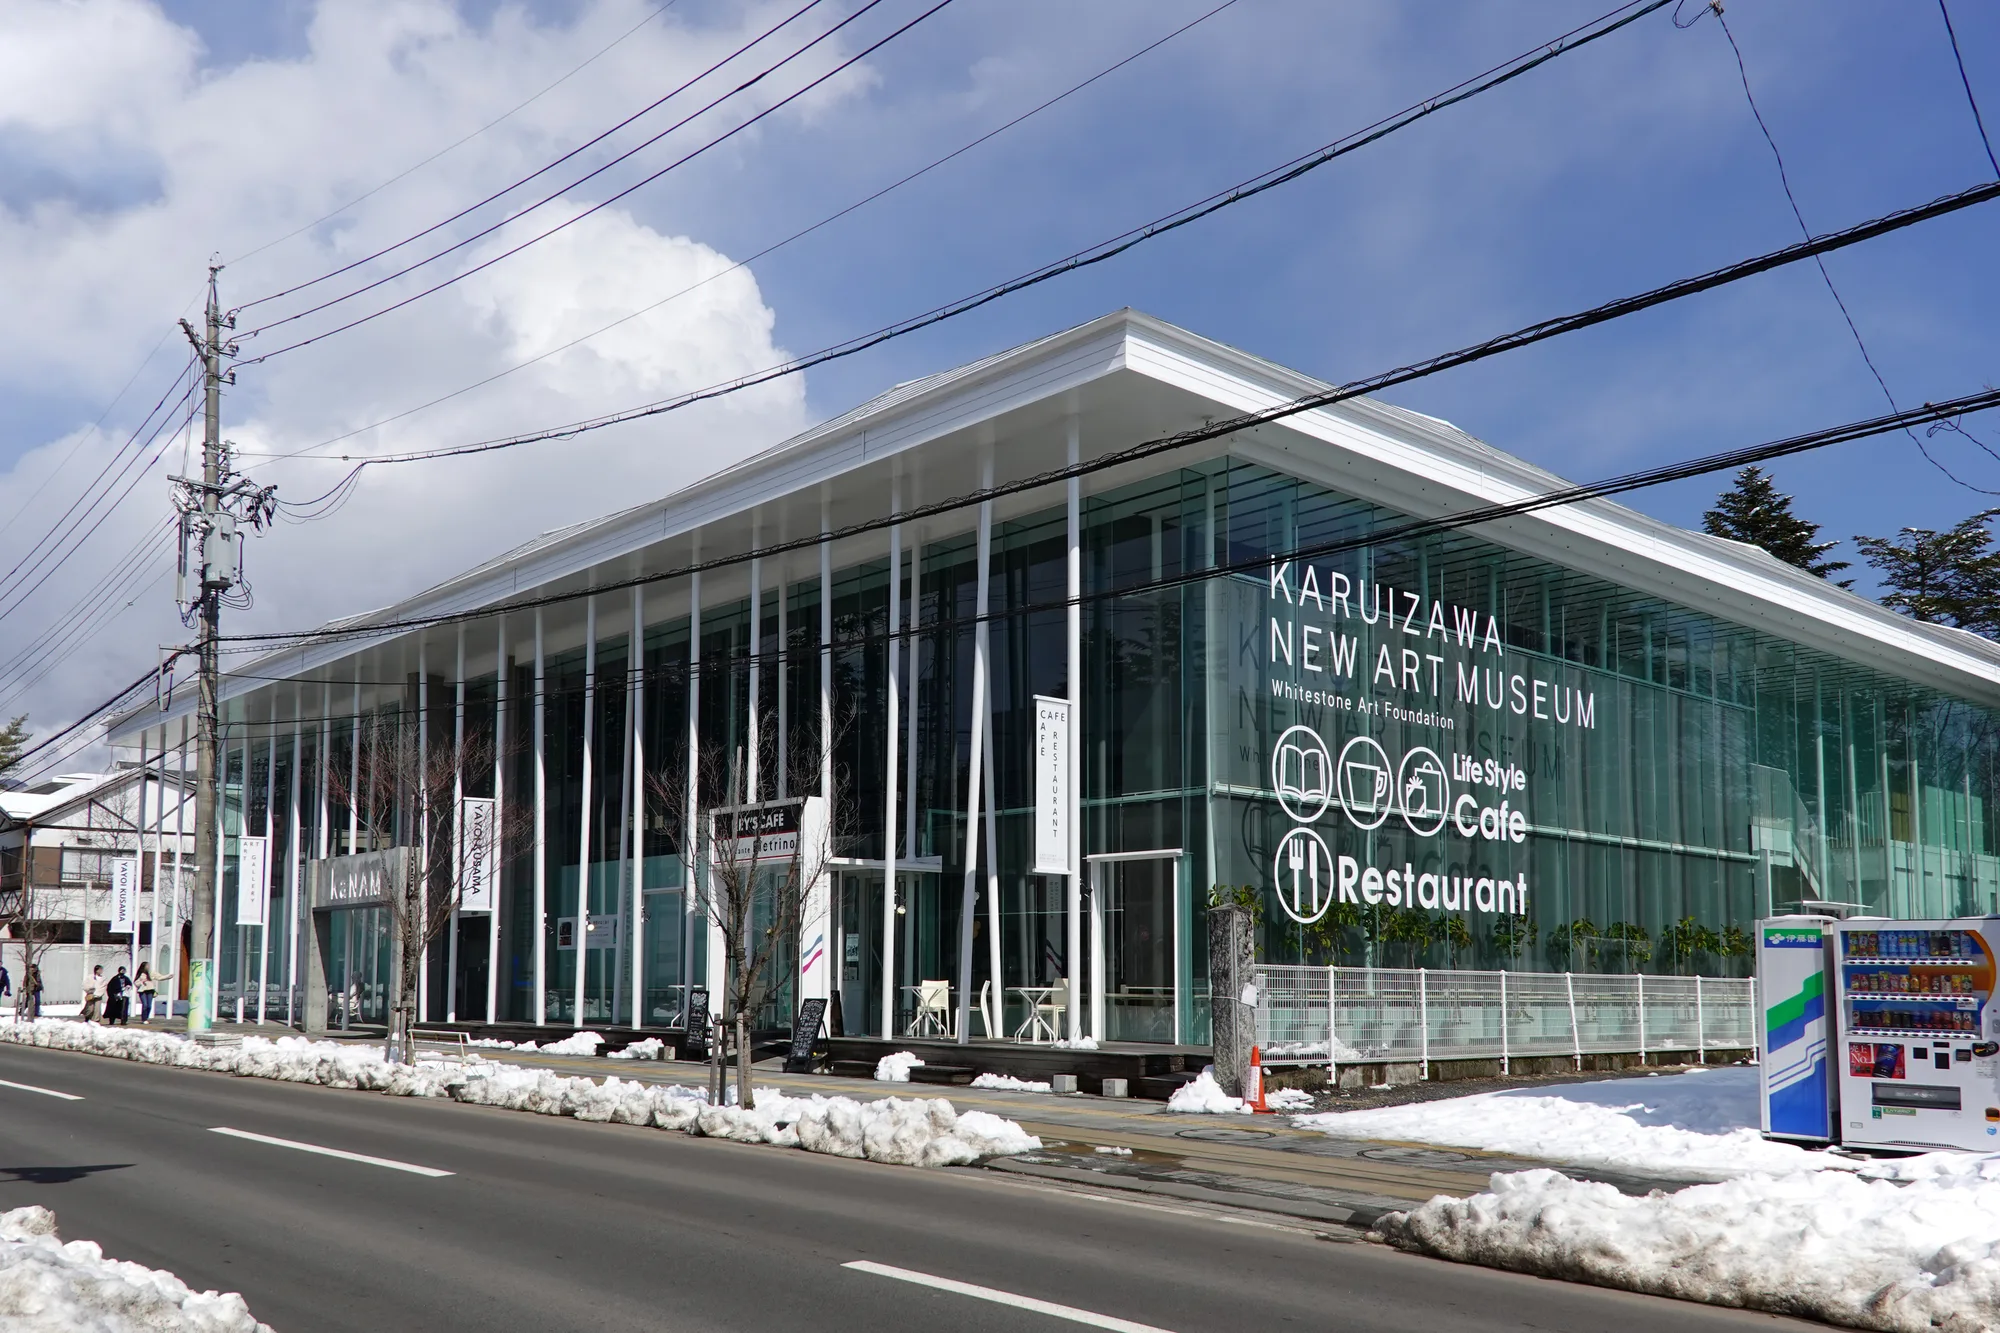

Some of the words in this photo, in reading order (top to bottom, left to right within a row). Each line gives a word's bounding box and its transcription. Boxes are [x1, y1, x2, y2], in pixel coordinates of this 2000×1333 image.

[1271, 554, 1502, 656] KARUIZAWA
[1271, 617, 1357, 678] NEW
[1374, 644, 1444, 697] ART
[1458, 661, 1595, 729] MUSEUM
[1040, 709, 1065, 722] CAFE
[1272, 679, 1351, 710] Whitestone
[1358, 697, 1379, 716] Art
[1385, 702, 1454, 730] Foundation
[1455, 793, 1526, 843] Cafe
[119, 861, 128, 887] YAYOI
[1338, 855, 1527, 915] Restaurant
[118, 888, 127, 922] KUSAMA
